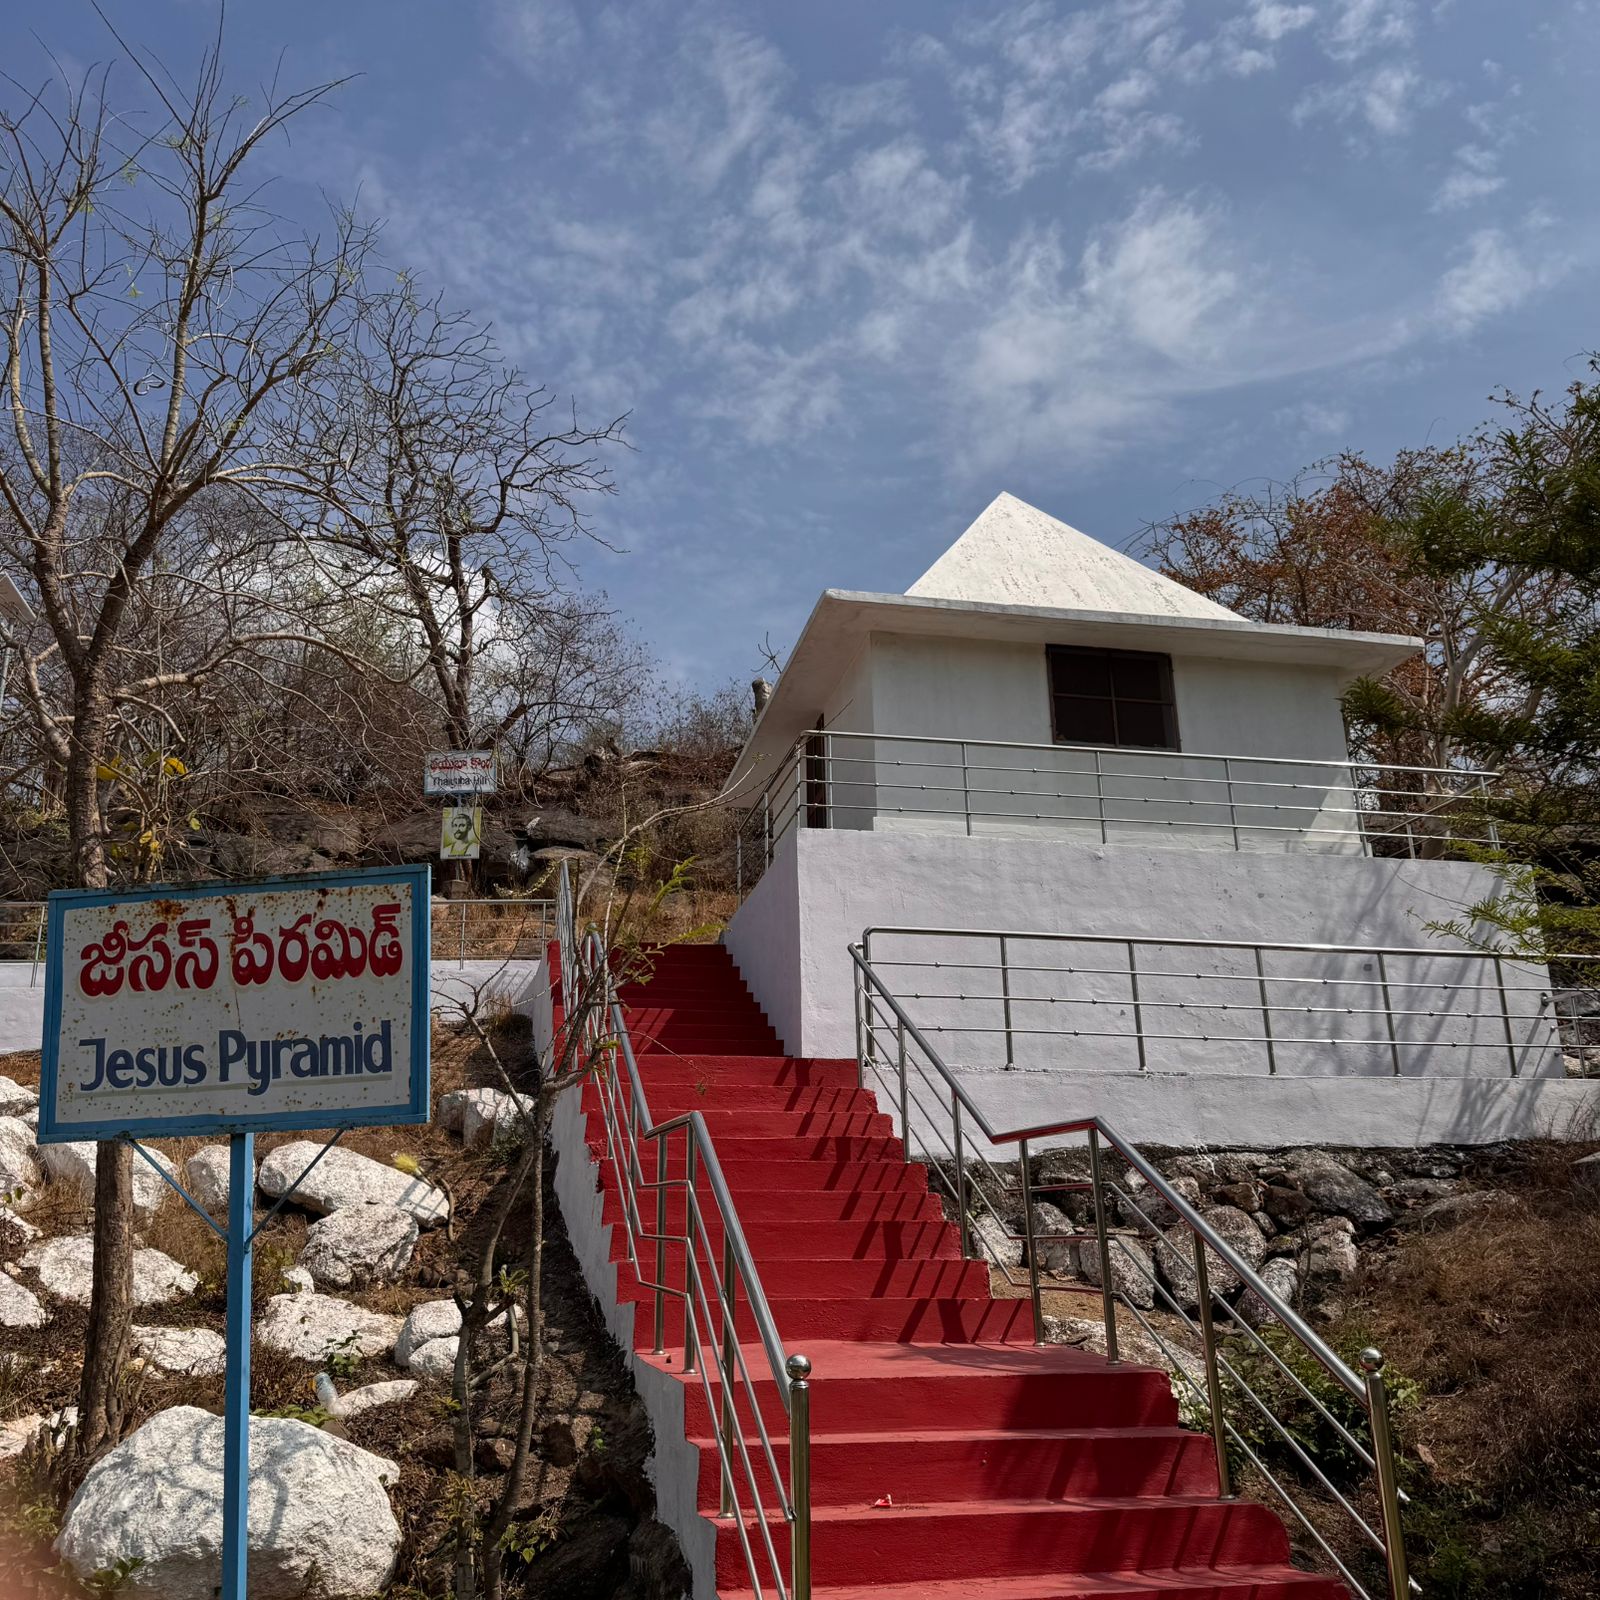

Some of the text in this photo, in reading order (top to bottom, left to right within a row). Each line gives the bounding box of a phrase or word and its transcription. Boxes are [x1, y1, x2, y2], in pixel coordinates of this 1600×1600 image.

[80, 919, 219, 997] జీసస్
[79, 1020, 391, 1096] Jesus Pyramid
